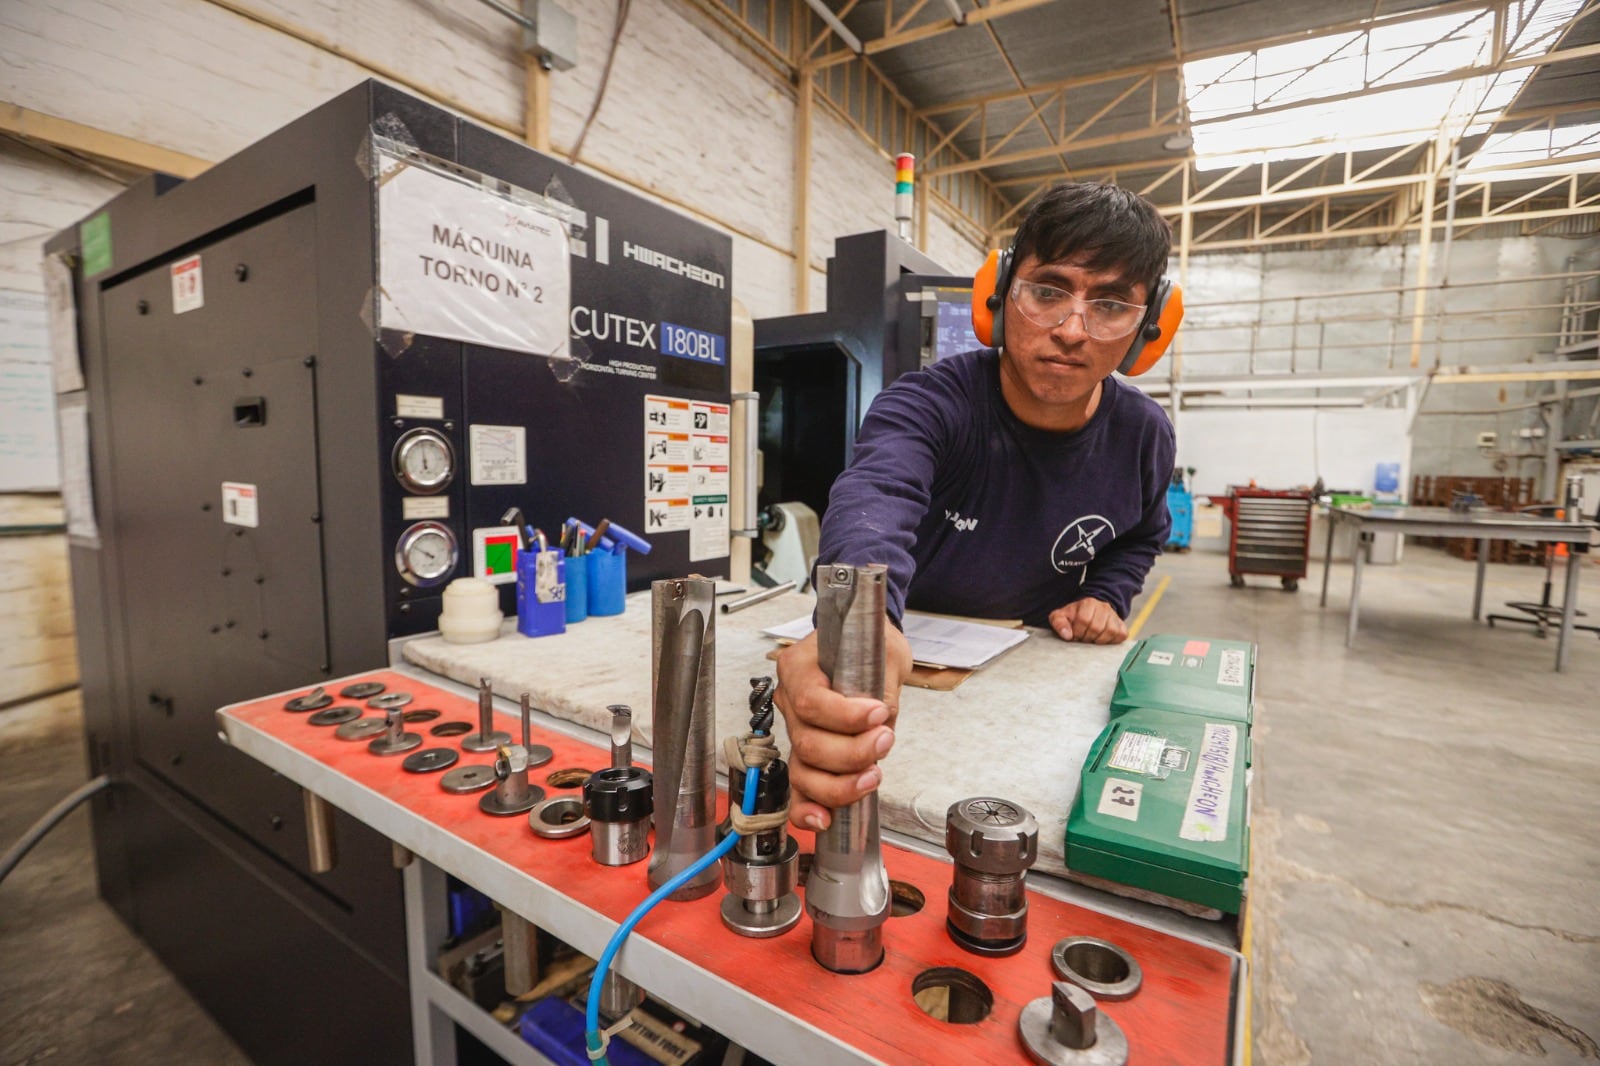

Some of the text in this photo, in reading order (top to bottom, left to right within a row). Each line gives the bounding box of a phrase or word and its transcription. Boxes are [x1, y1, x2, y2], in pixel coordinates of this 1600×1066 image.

[432, 224, 534, 271] MÁQUINA
[623, 240, 725, 289] HWACHEON
[419, 255, 500, 293] TORNO
[534, 286, 544, 304] 2
[570, 305, 721, 362] CUTEX 180BL
